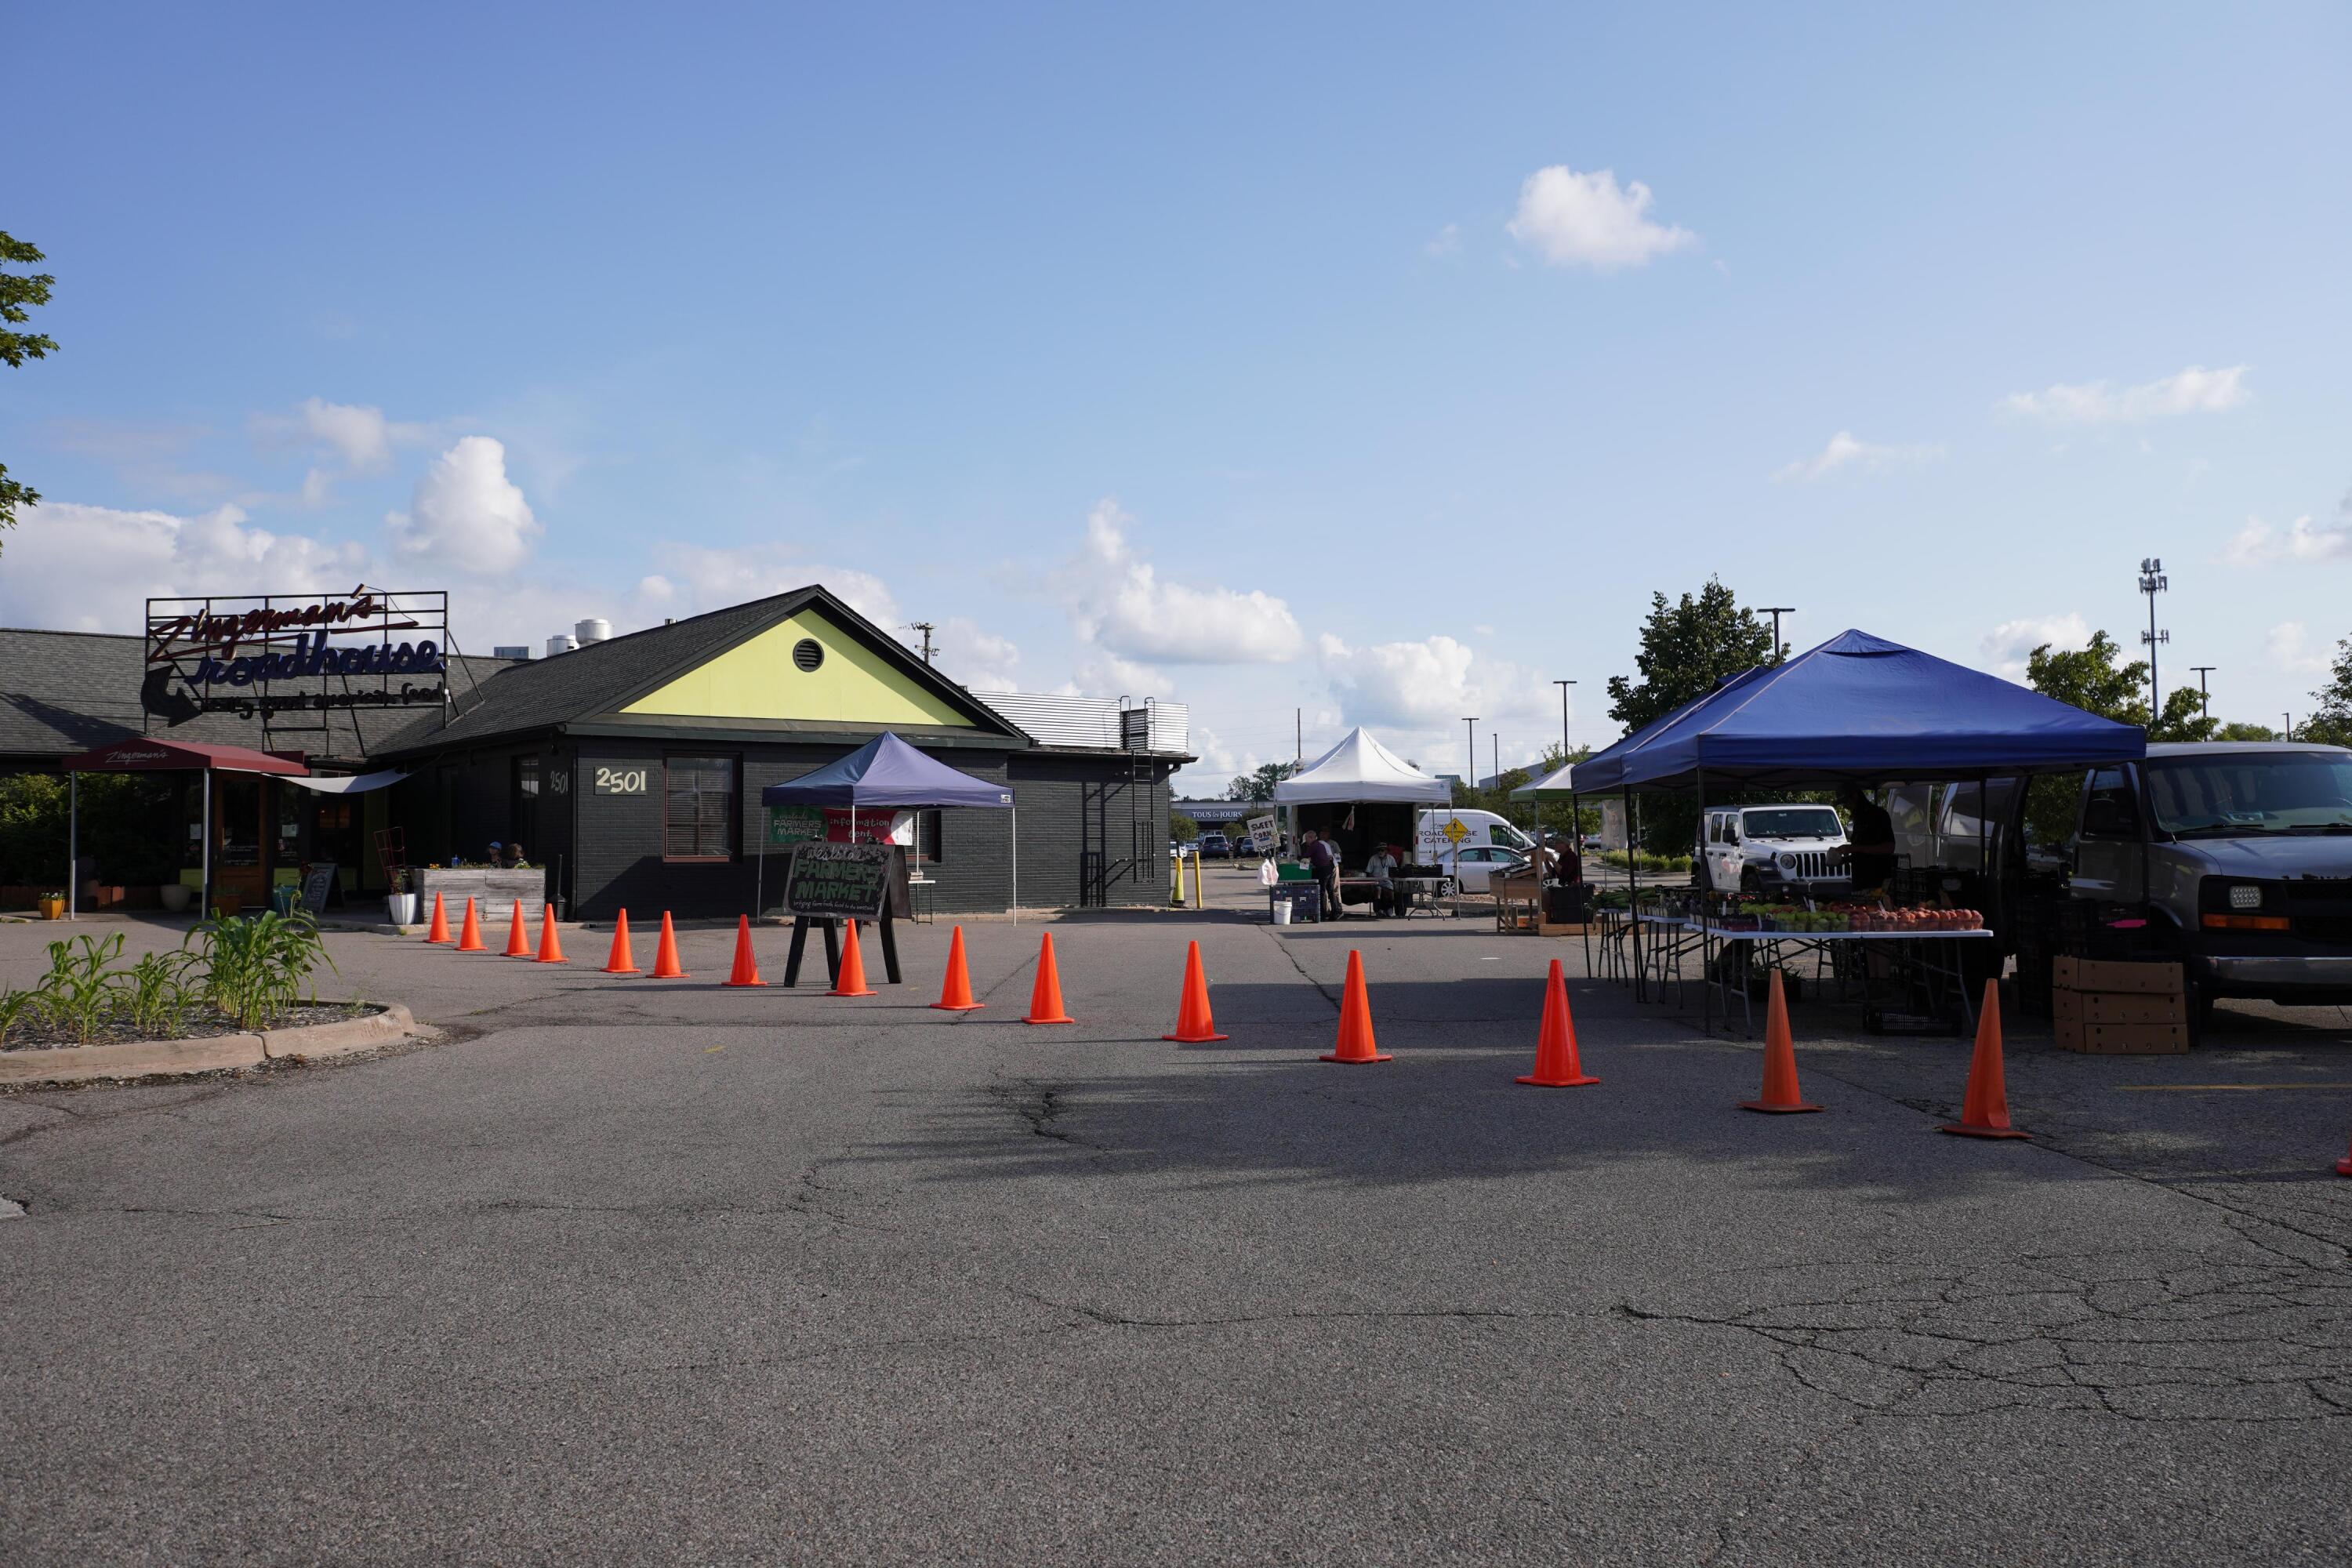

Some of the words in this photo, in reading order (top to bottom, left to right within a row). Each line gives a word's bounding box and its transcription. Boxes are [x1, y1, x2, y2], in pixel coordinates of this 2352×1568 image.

[149, 583, 388, 663] Zingerman's
[183, 630, 445, 687] roadhouse
[401, 681, 442, 705] food
[550, 771, 568, 793] 2501
[596, 768, 646, 793] 2501
[774, 819, 822, 829] FARMERS
[830, 818, 890, 826] infomation
[1250, 820, 1273, 831] SWEET
[1253, 829, 1272, 840] CORN
[793, 859, 879, 880] FARMERS
[795, 881, 878, 901] MARKET
